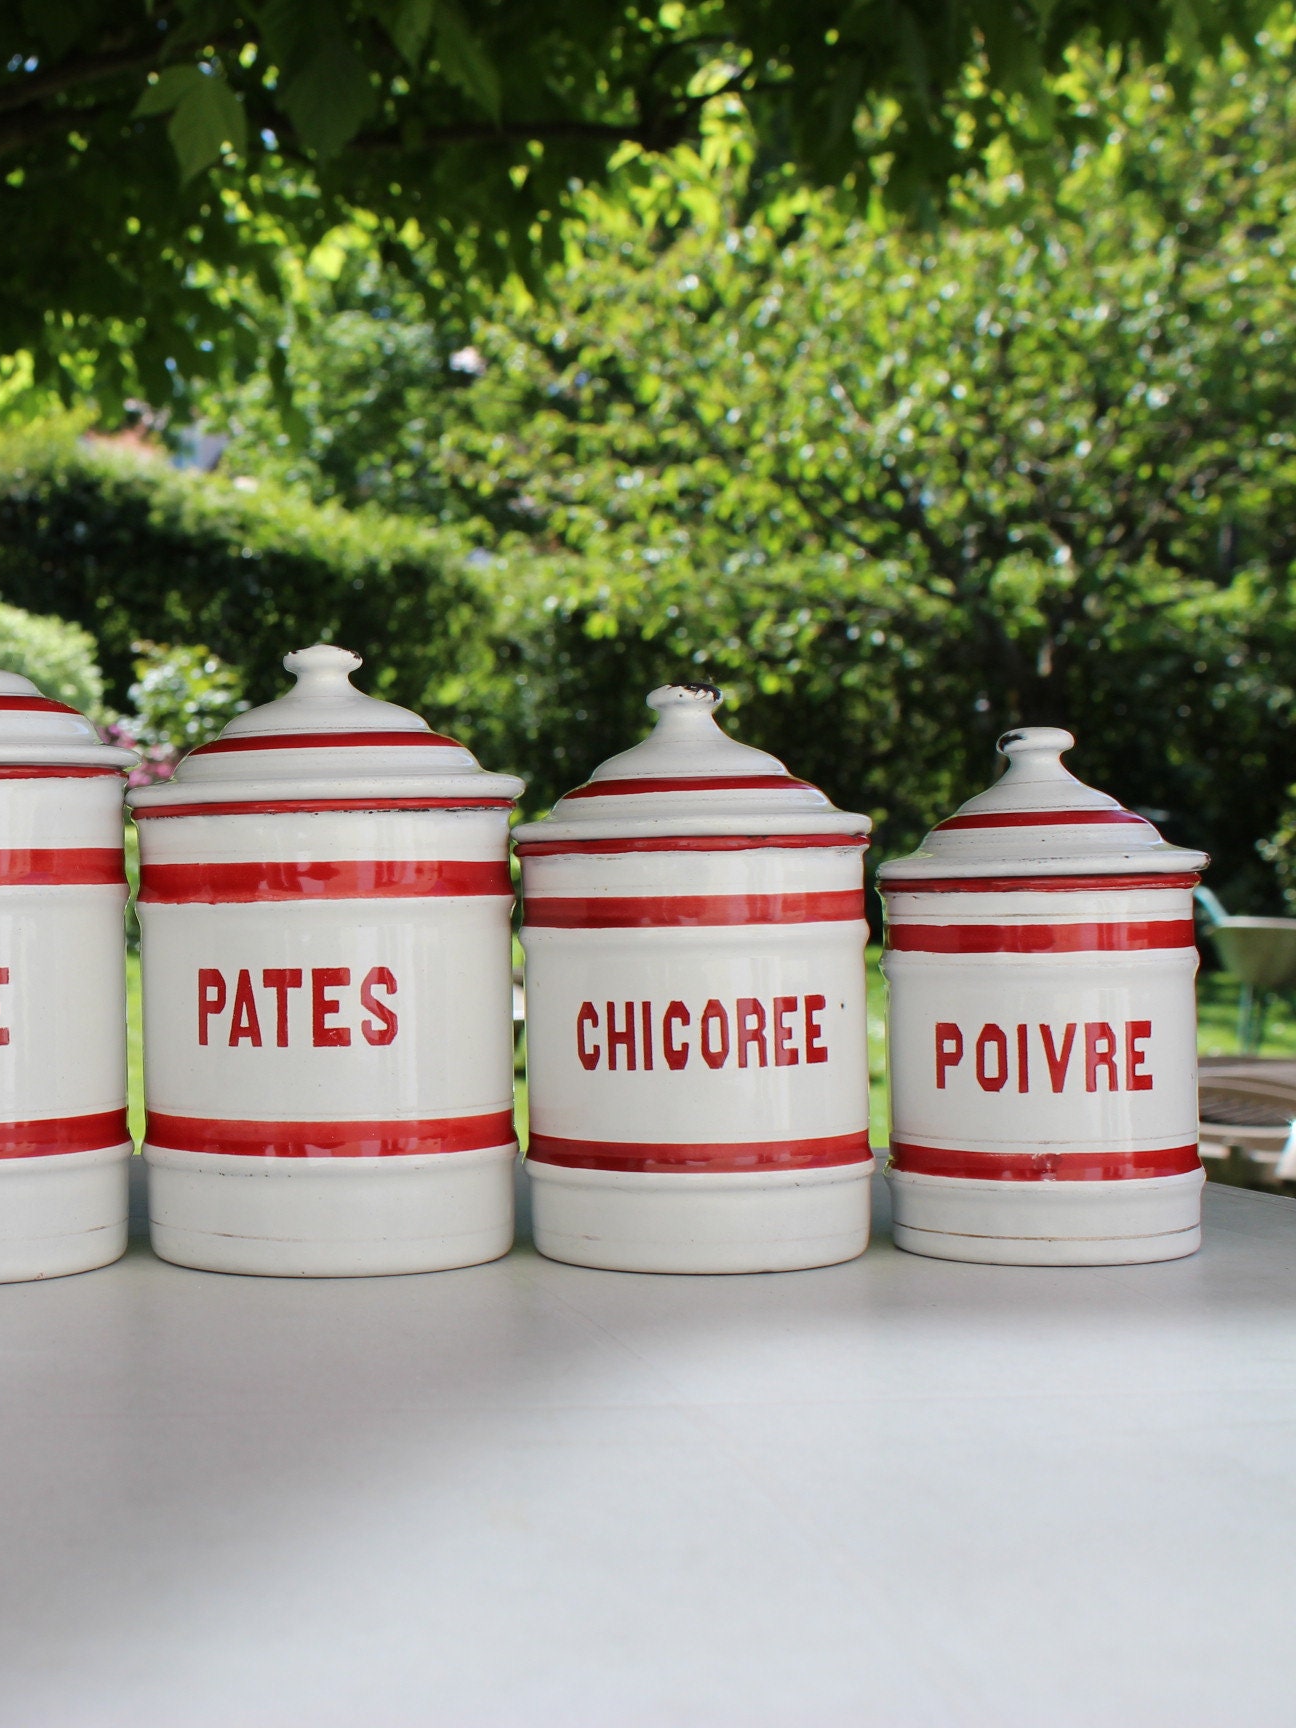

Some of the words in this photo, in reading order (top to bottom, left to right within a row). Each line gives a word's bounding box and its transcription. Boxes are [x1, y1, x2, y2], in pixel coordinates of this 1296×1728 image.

[199, 967, 397, 1047] PATES
[577, 995, 827, 1070] CHICOREE
[935, 1021, 1153, 1093] POIVRE
